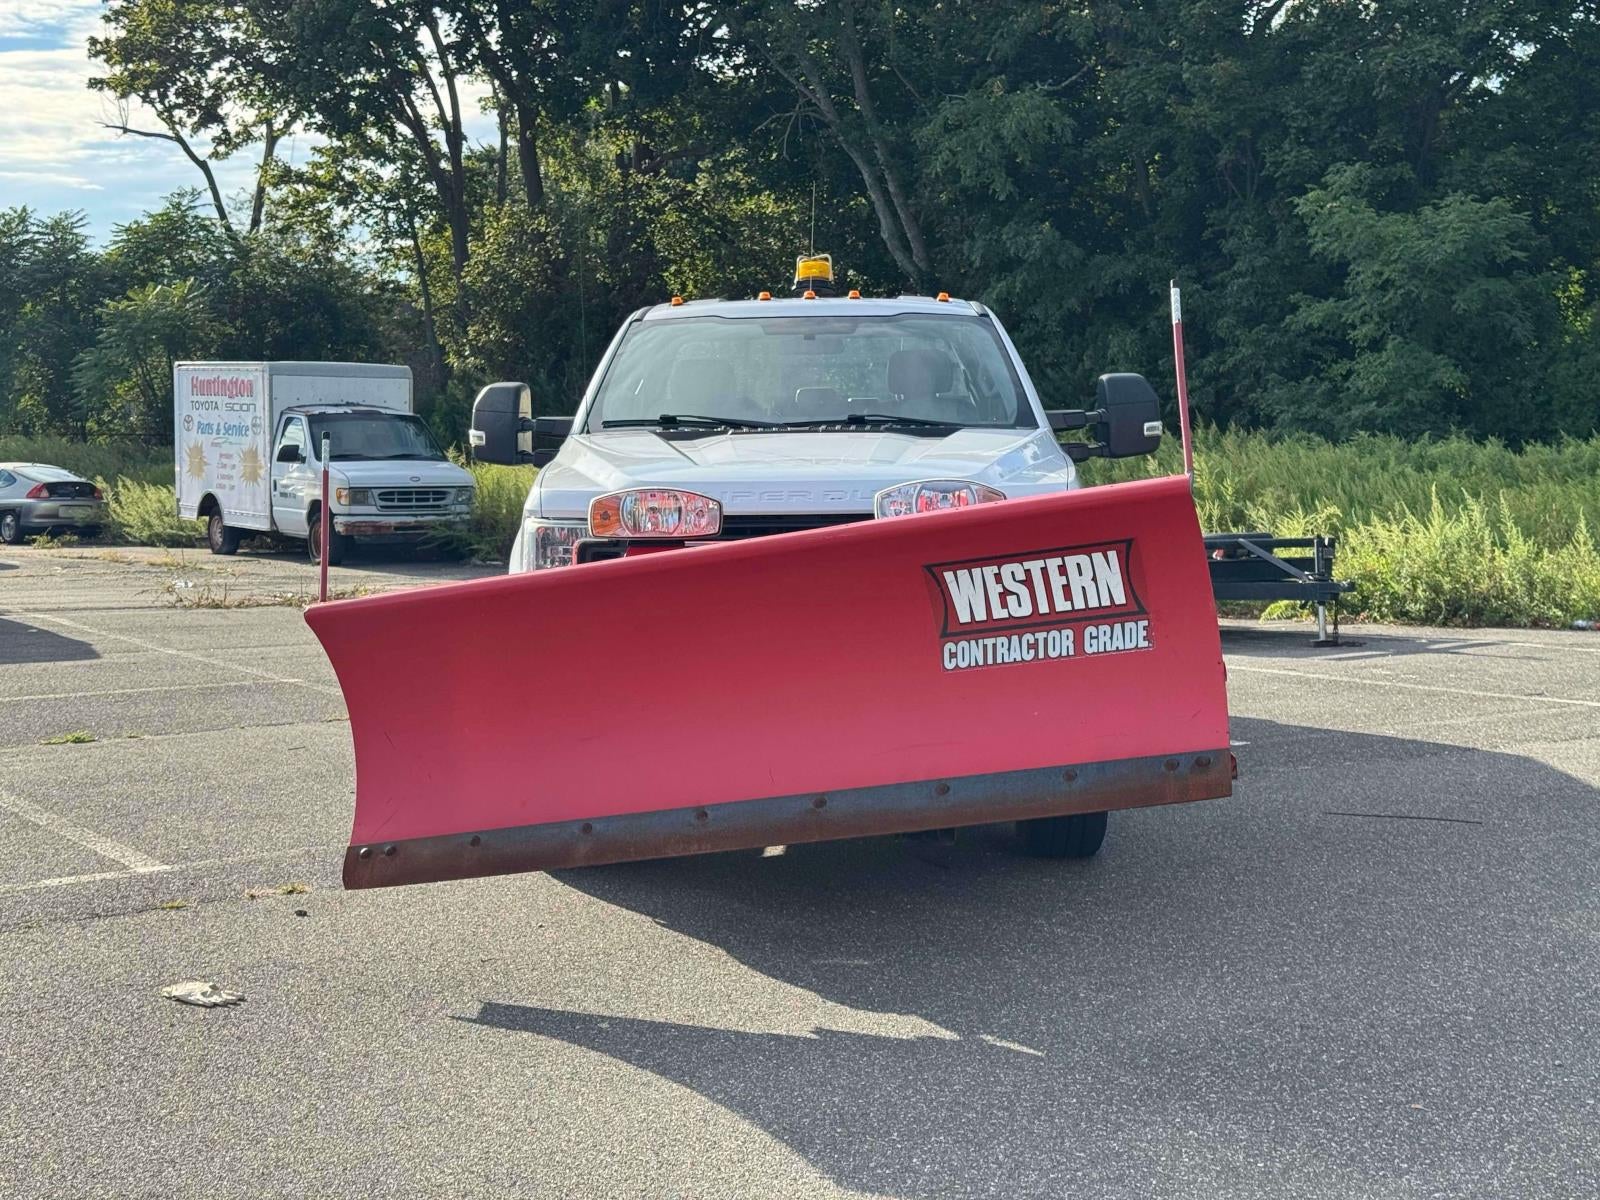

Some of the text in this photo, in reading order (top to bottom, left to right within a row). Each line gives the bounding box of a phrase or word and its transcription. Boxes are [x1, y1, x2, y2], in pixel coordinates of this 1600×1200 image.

[191, 375, 253, 399] Huntington
[190, 400, 220, 411] TOYOTA
[196, 420, 250, 438] Parts & Service
[943, 550, 1127, 624] WESTERN
[943, 619, 1150, 670] CONTRACTOR GRADE
